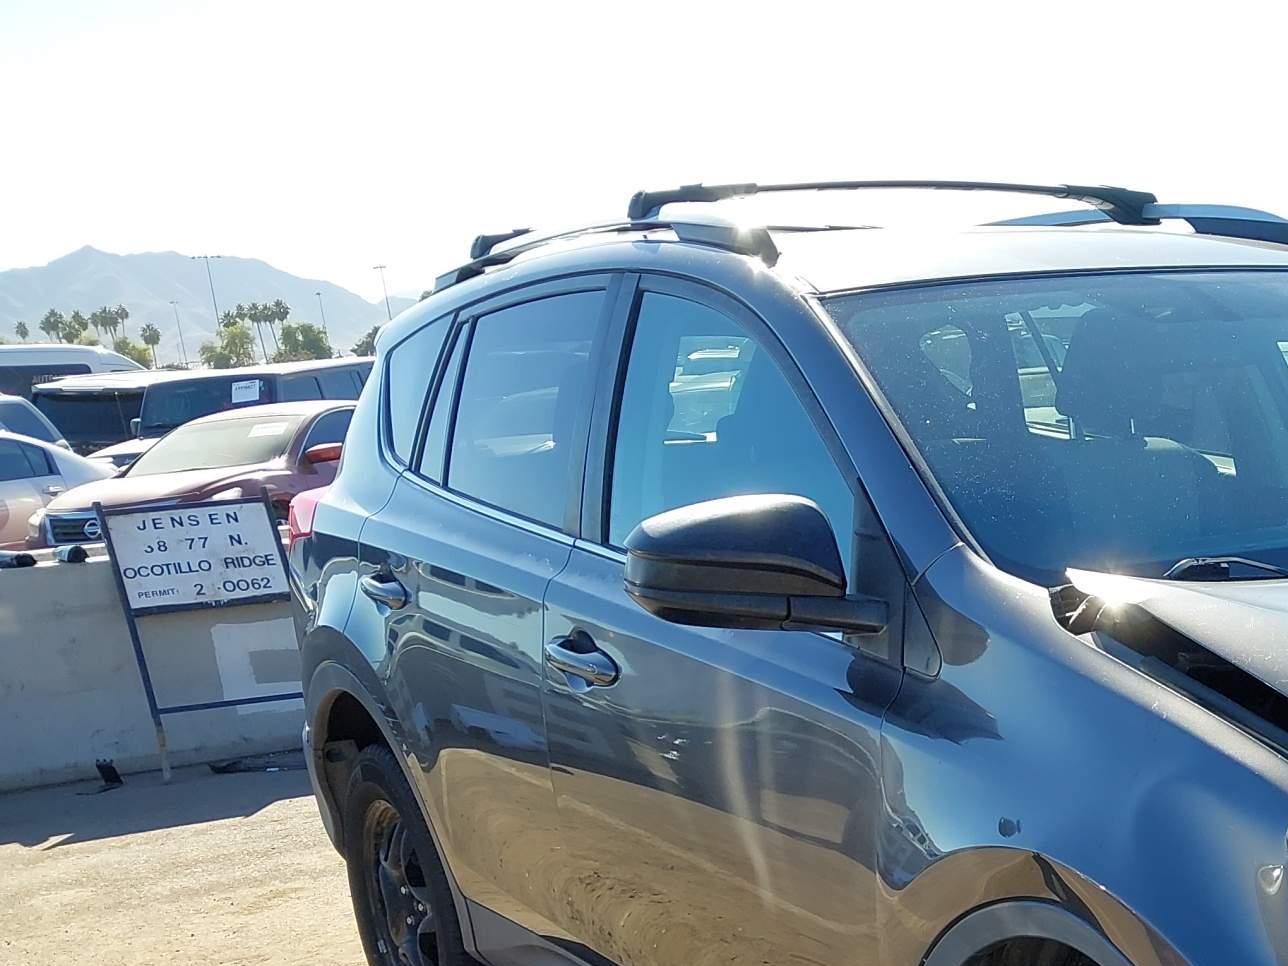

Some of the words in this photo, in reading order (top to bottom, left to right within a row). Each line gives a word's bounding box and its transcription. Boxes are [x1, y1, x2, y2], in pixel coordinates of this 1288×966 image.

[136, 511, 240, 531] JENSEN
[228, 533, 248, 547] N.
[123, 559, 212, 580] OCOTILLO
[223, 553, 277, 570] RIDGE
